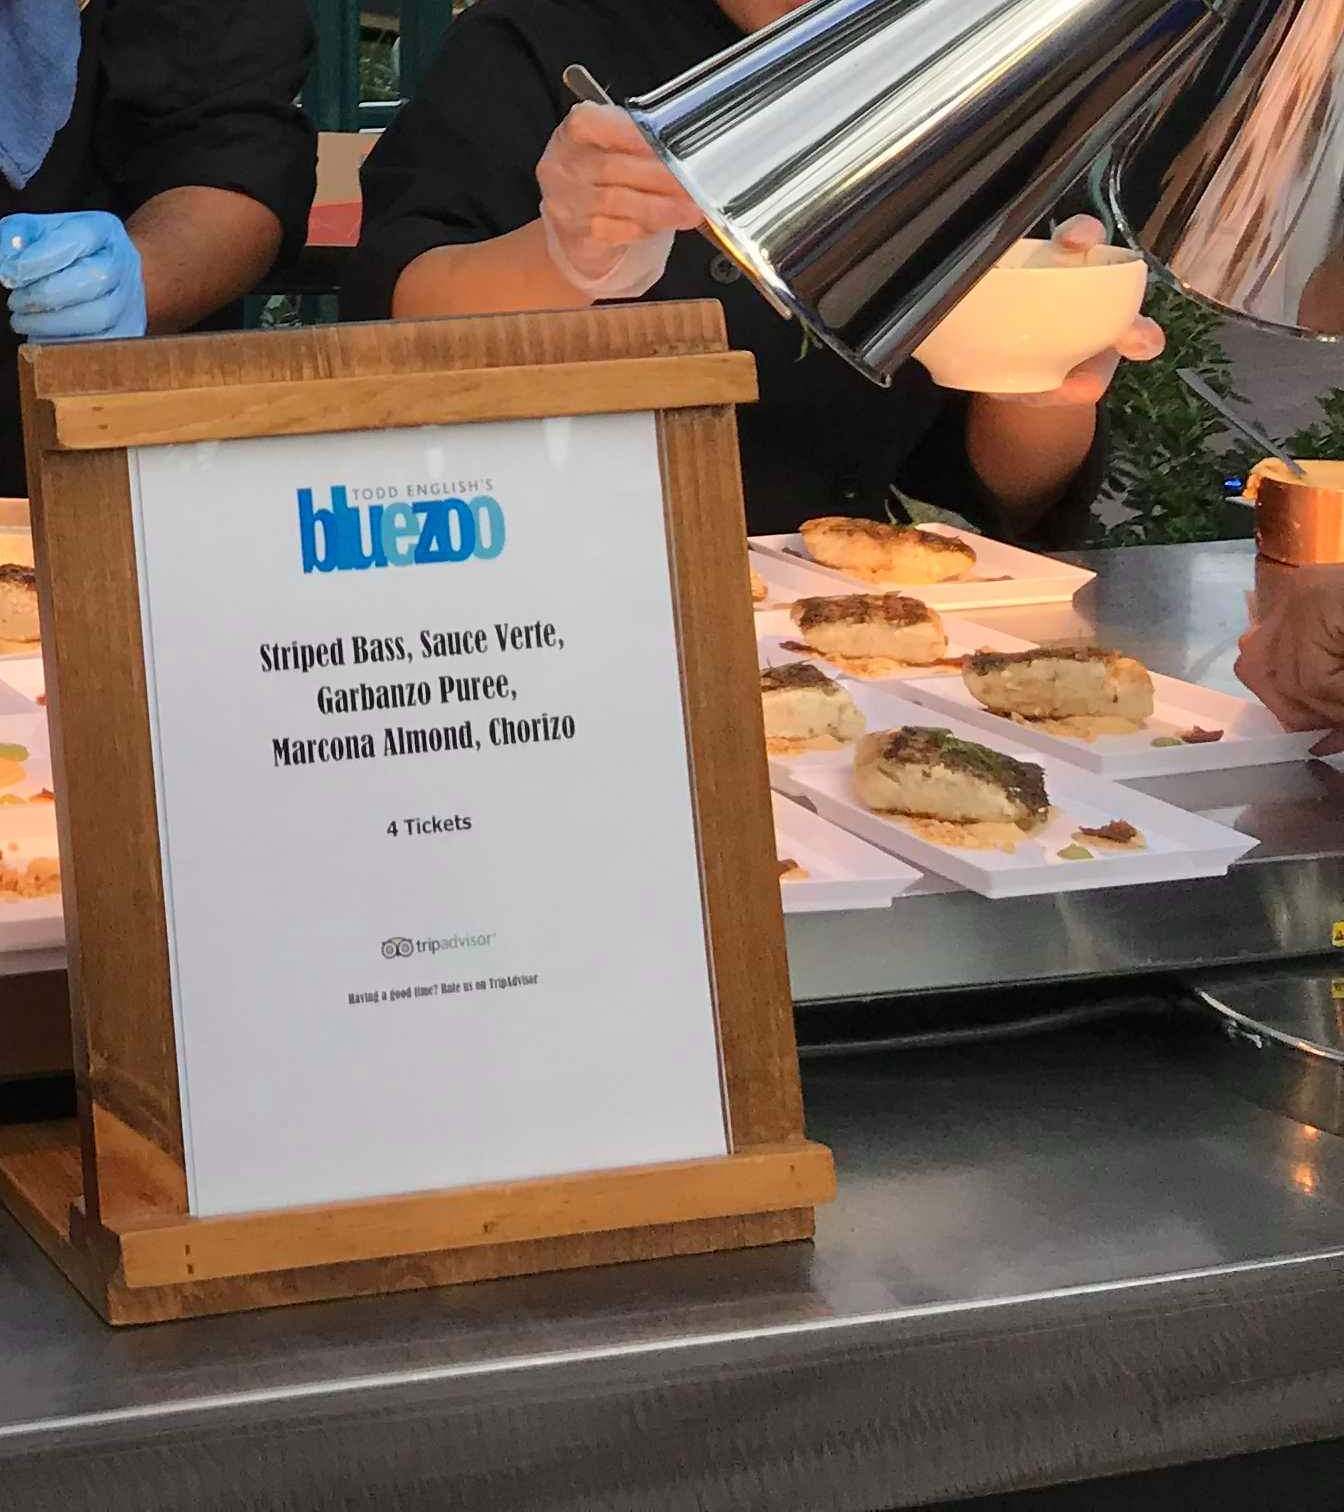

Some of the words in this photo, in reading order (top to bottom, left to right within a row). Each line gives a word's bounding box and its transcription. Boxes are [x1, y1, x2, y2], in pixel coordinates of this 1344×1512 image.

[352, 486, 399, 501] TODD
[407, 478, 494, 498] ENGLISH'S
[296, 485, 506, 574] bluezoo
[259, 638, 345, 673] Striped
[351, 635, 413, 665] Bass,
[420, 627, 488, 659] Sauce
[493, 620, 565, 652] Verte,
[316, 681, 432, 716] Garbanzo
[438, 673, 518, 704] Puree,
[271, 734, 376, 767] Marcona
[383, 721, 482, 757] Almond,
[488, 713, 576, 746] Chorizo
[386, 820, 399, 837] 4
[404, 814, 473, 835] Tickets
[416, 933, 492, 954] tripadvisor
[348, 992, 379, 1005] Having
[390, 987, 412, 1002] good
[463, 982, 473, 992] us
[489, 974, 538, 990] TripAdvisor
